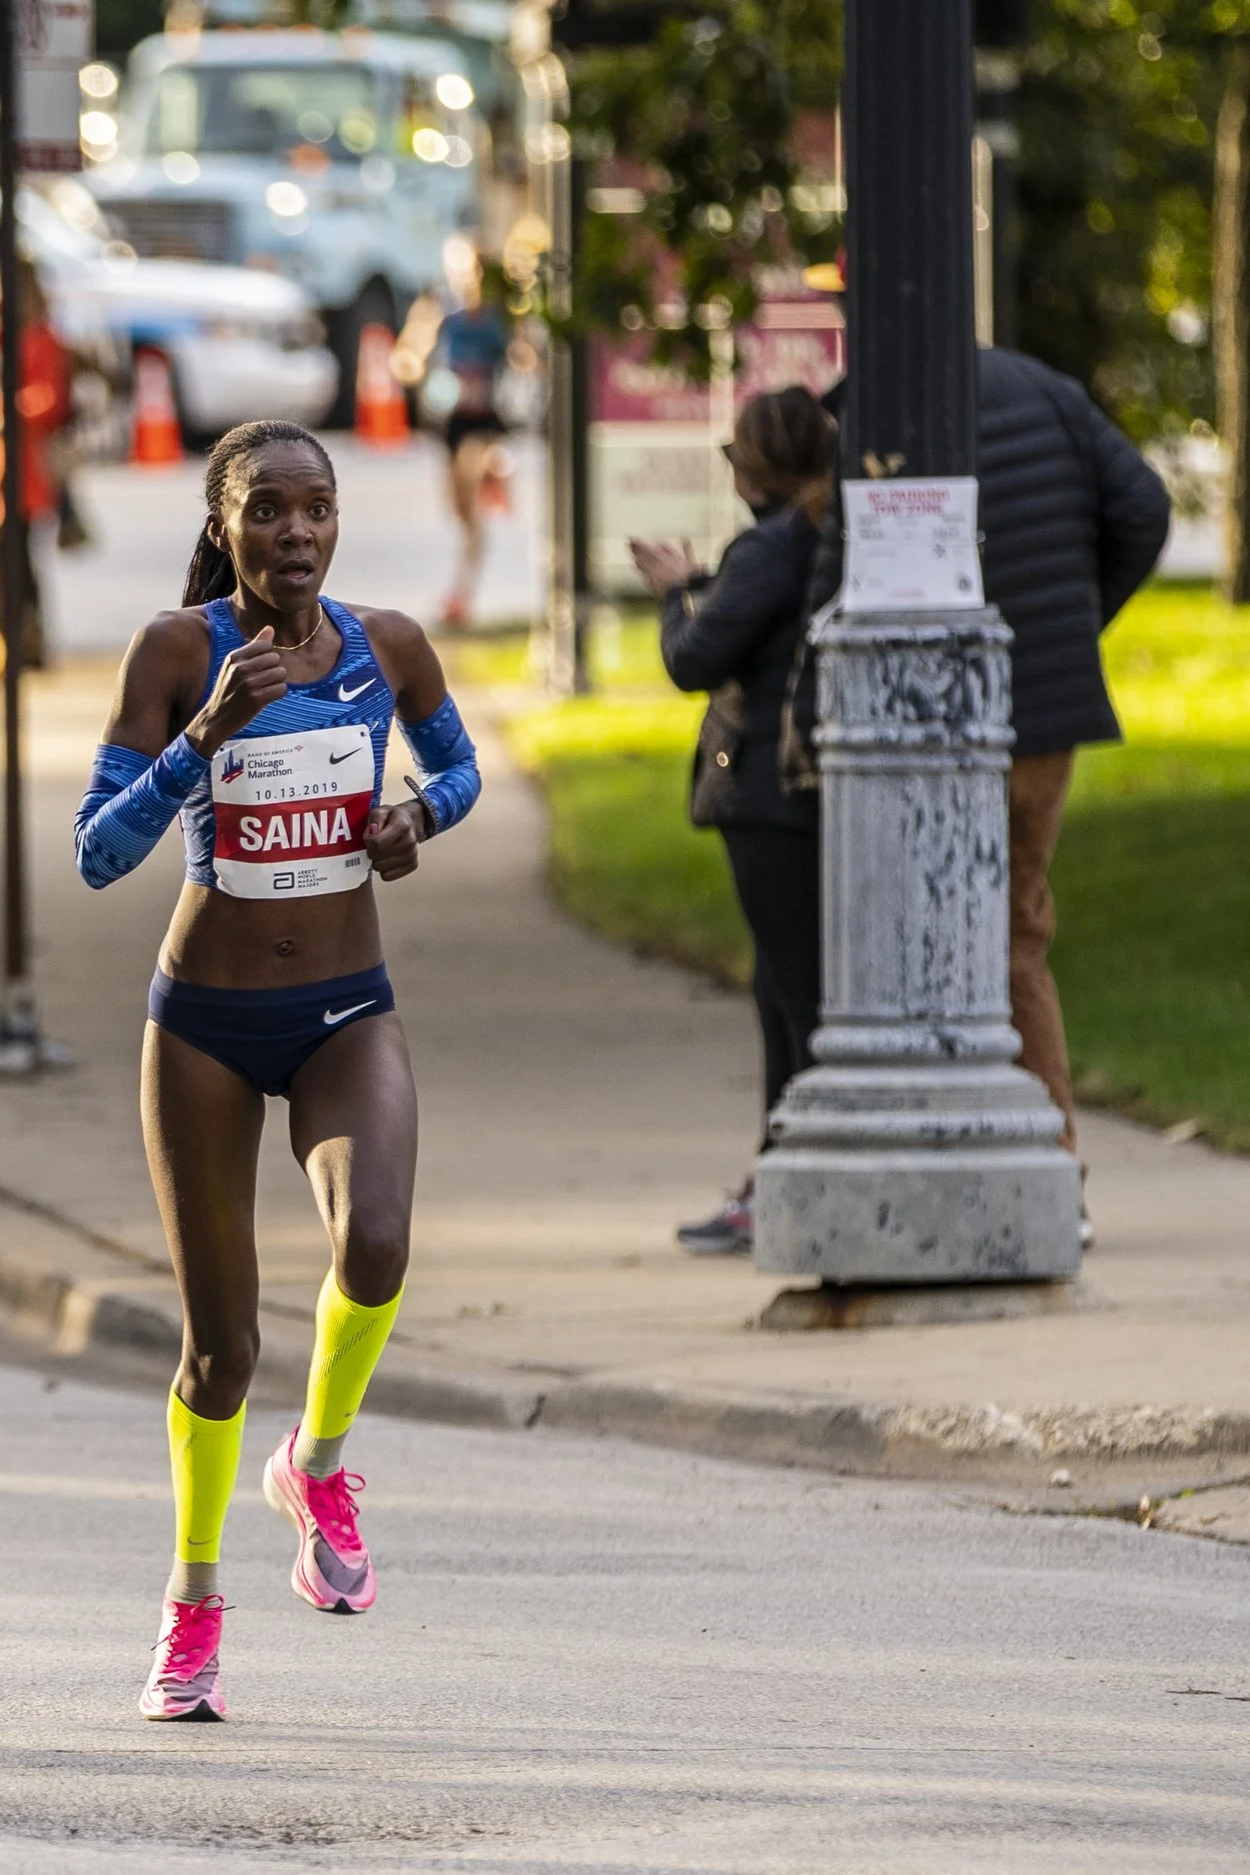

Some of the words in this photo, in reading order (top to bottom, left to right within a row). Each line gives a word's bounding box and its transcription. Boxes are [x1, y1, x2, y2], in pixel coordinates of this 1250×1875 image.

[247, 758, 284, 770] Chicago
[248, 767, 293, 779] Marathon
[255, 781, 338, 801] 10.13.2019
[239, 807, 352, 852] SAINA
